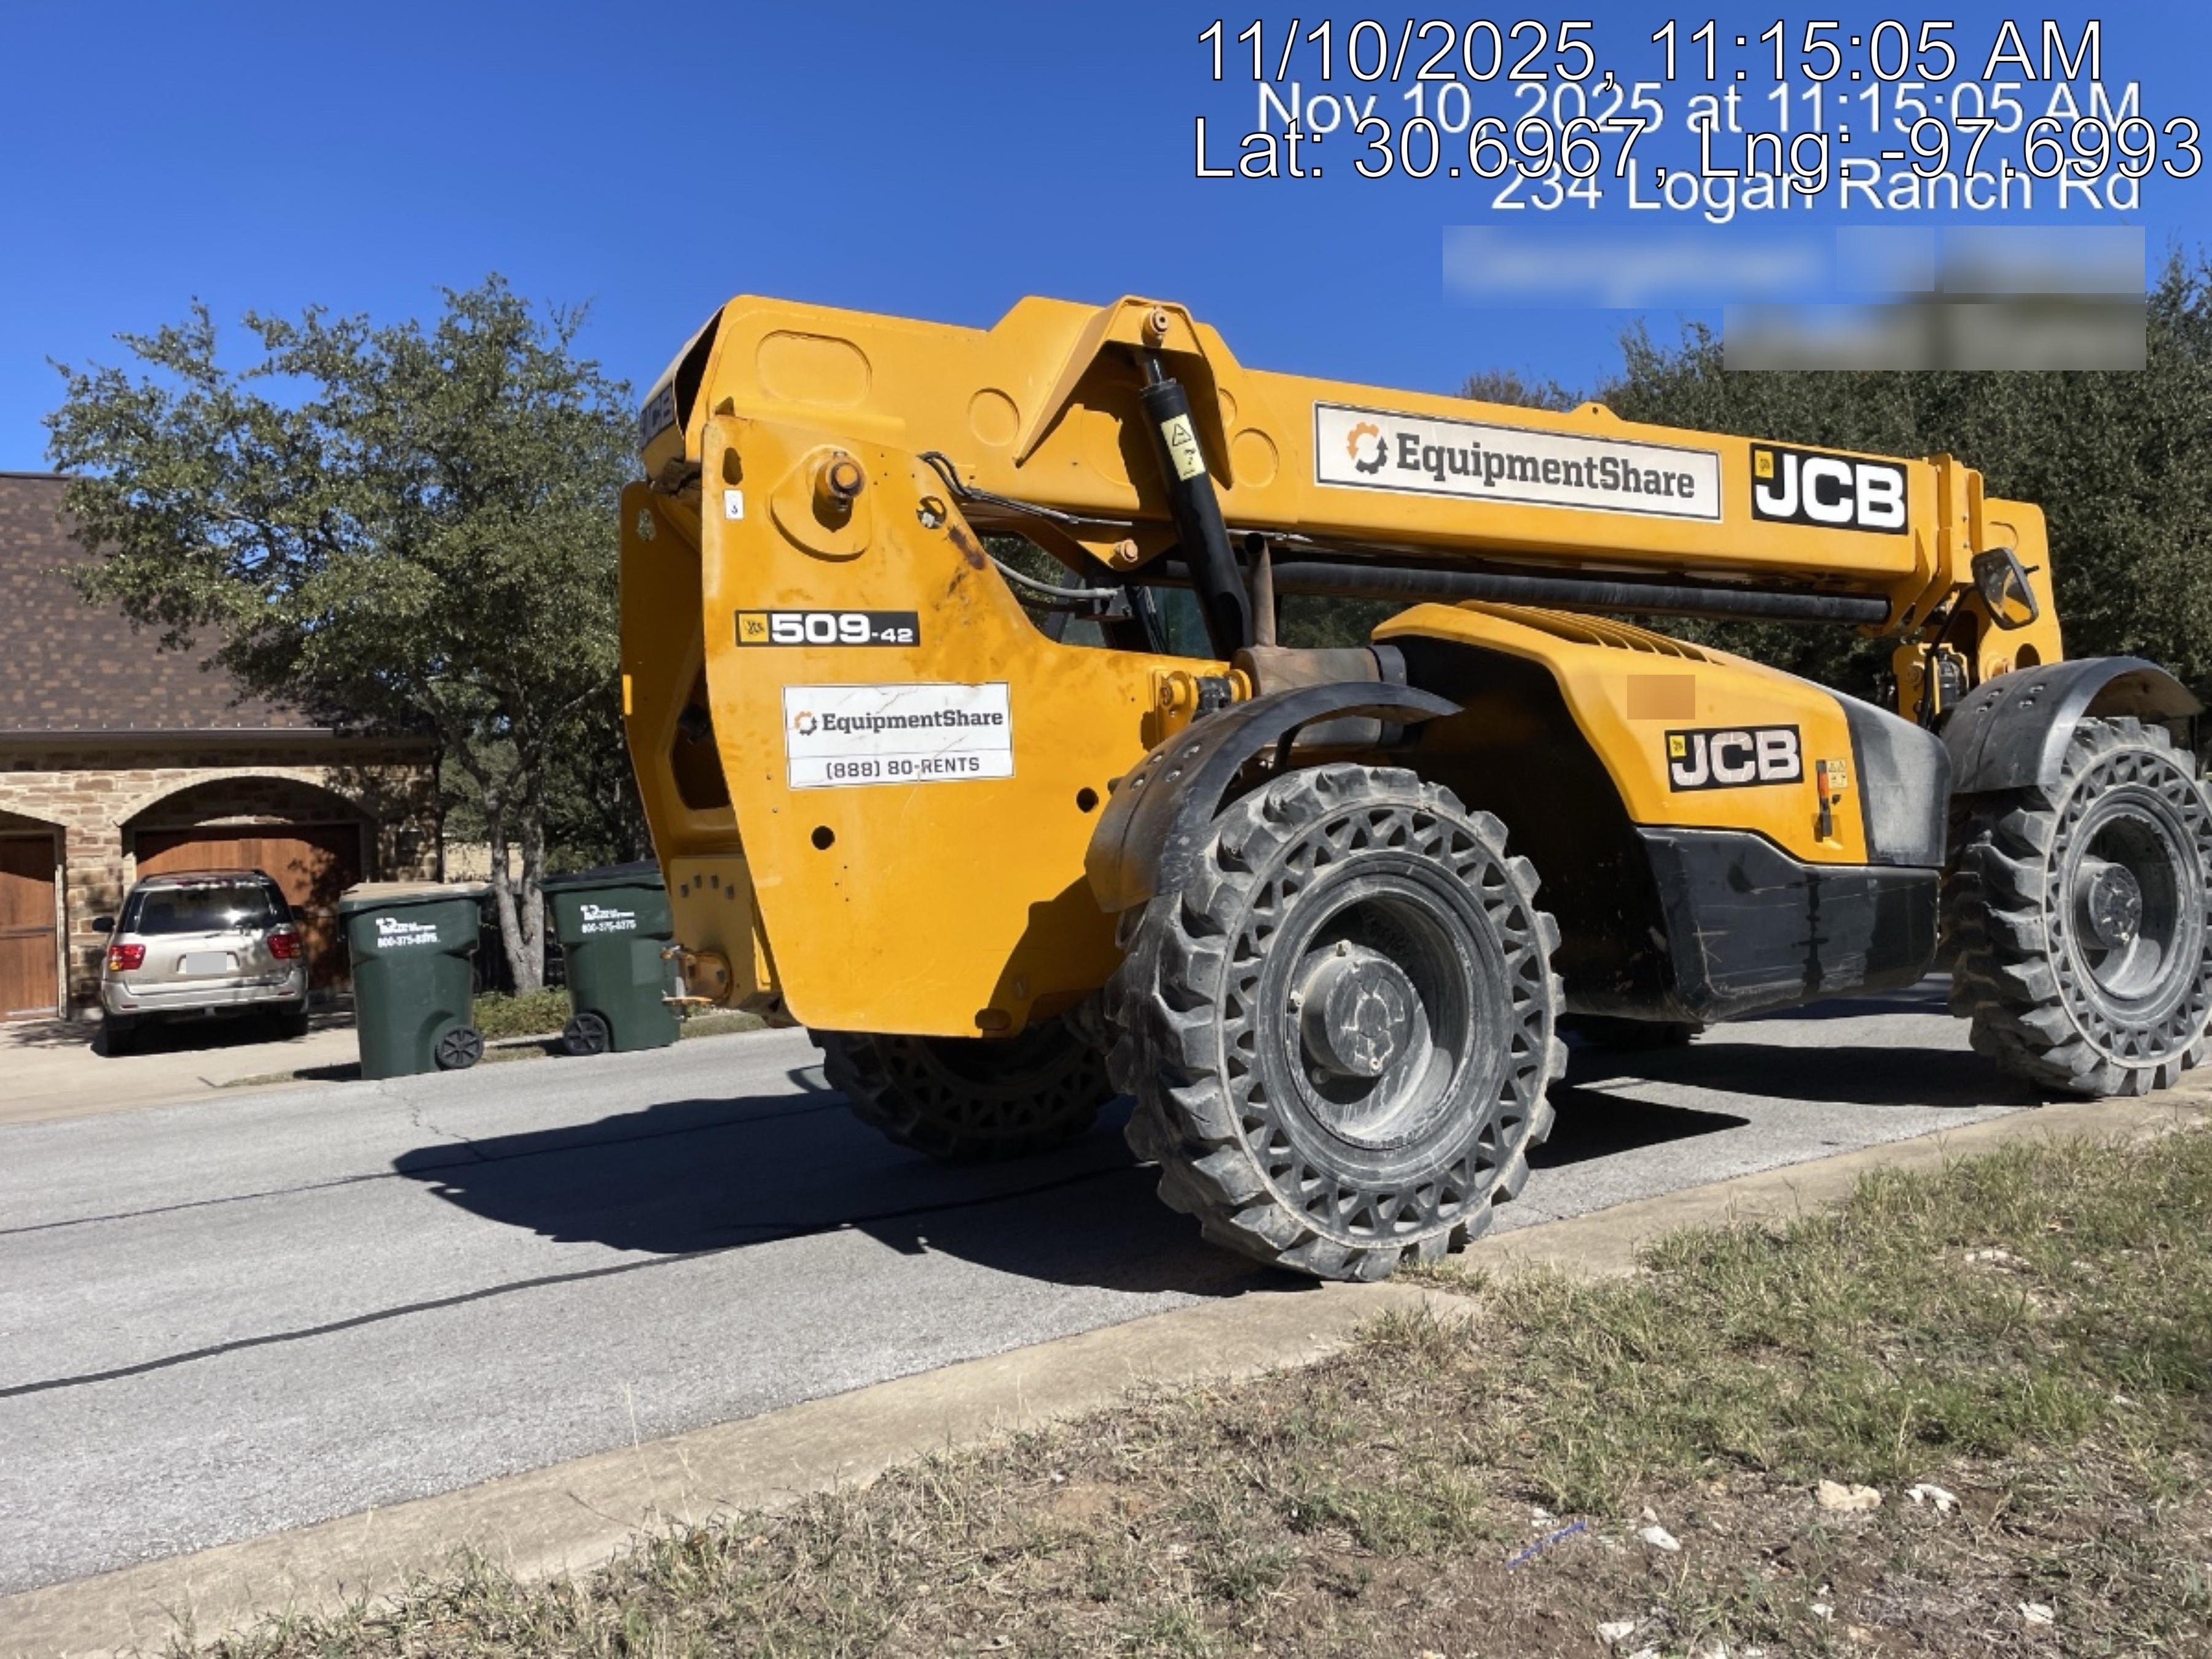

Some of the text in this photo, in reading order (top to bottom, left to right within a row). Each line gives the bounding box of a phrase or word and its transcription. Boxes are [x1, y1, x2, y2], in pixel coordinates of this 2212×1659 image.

[1396, 432, 1695, 499] EquipmentShare
[1755, 453, 1907, 529] JCB
[771, 613, 914, 643] 509-42
[822, 709, 1003, 734] EquipmentShare
[826, 756, 980, 780] (888) 80-RENTS
[1671, 729, 1800, 786] JCB
